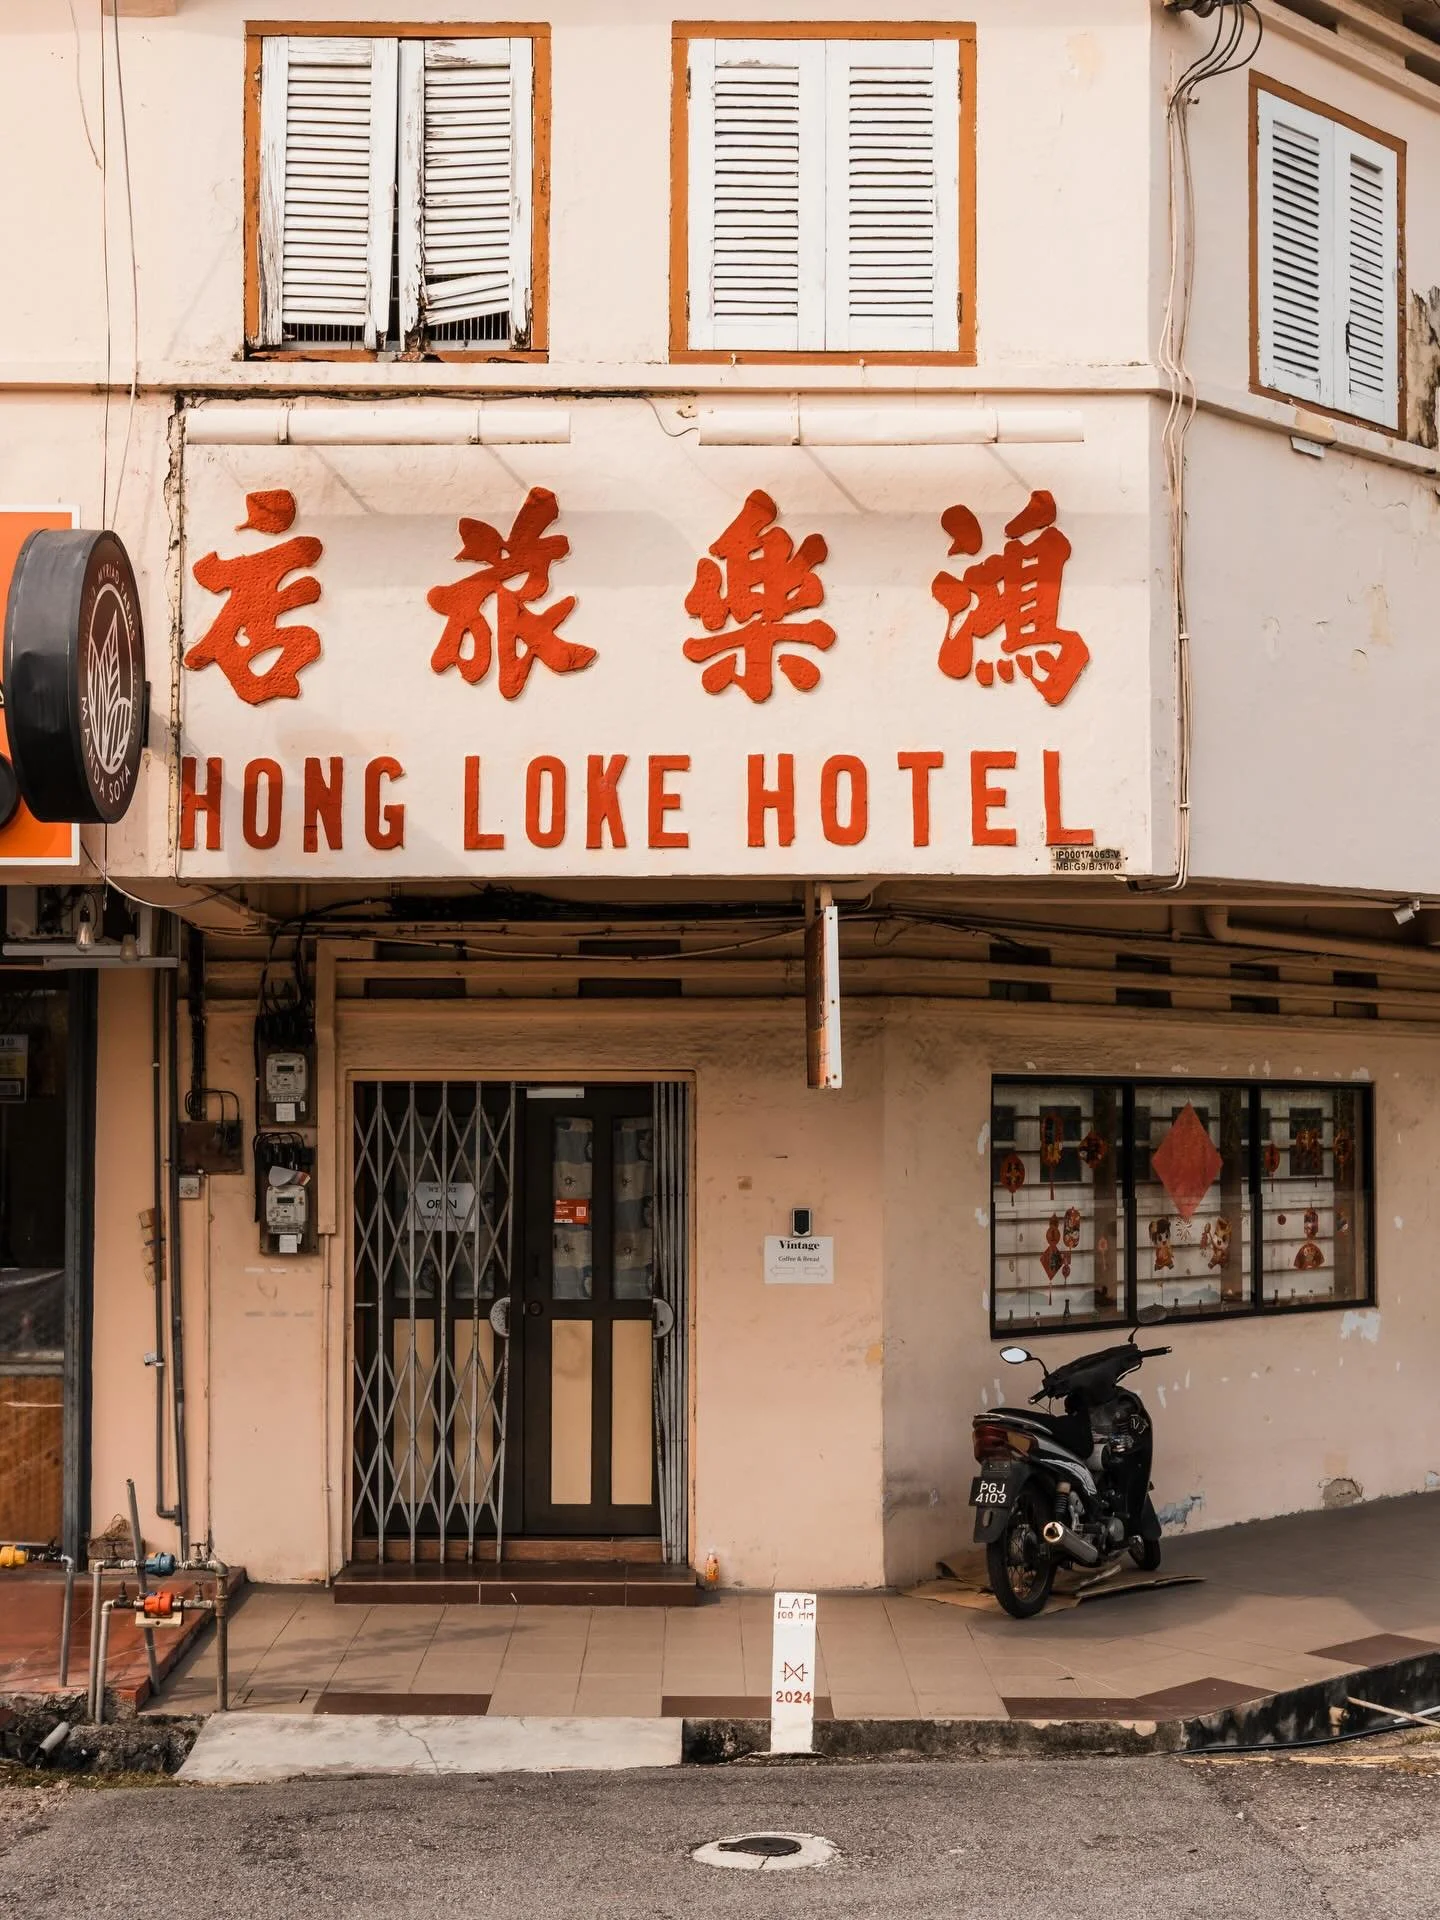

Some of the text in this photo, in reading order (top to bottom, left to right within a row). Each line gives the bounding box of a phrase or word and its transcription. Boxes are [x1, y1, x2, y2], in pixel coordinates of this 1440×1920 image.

[81, 697, 131, 804] MANDA SOYA
[179, 749, 1094, 853] HONG LOKE HOTEL
[427, 1199, 458, 1209] OPN
[779, 1240, 820, 1251] Vintage
[980, 1482, 1005, 1493] PGJ
[975, 1493, 1006, 1503] 4103
[778, 1598, 815, 1609] LAP
[777, 1611, 815, 1620] 100 MM
[775, 1690, 812, 1704] 2024
